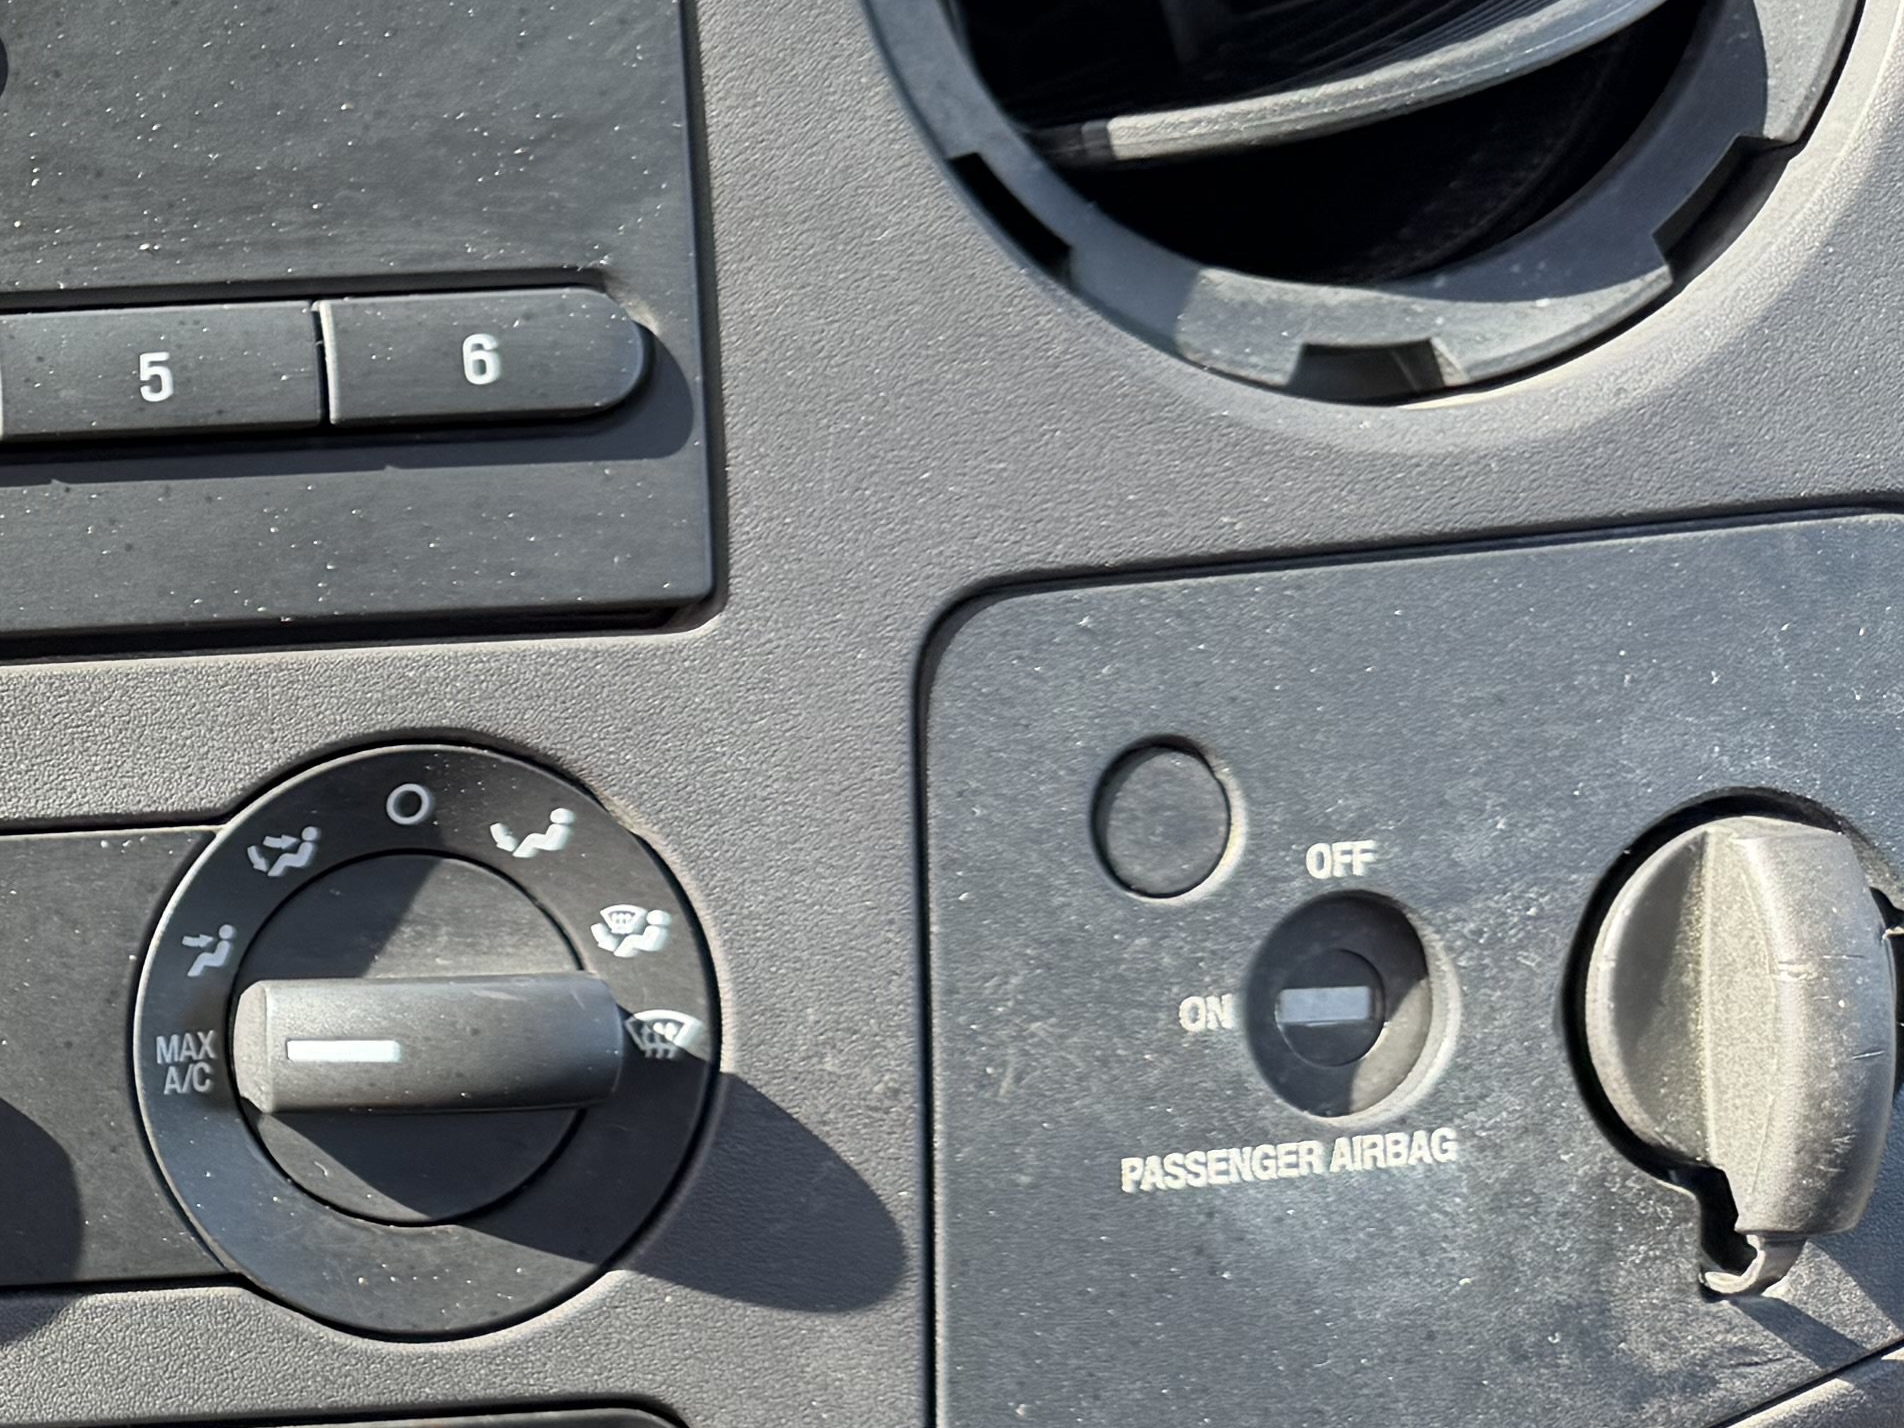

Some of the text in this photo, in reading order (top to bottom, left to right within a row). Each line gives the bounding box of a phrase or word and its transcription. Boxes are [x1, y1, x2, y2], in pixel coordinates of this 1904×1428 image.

[140, 352, 172, 401] 5
[463, 334, 499, 384] 6
[1306, 840, 1377, 879] OFF
[1179, 994, 1237, 1032] ON
[157, 1030, 215, 1064] MAX
[164, 1062, 211, 1095] A/C
[1121, 1128, 1459, 1193] PASSENGER AIRBAG
